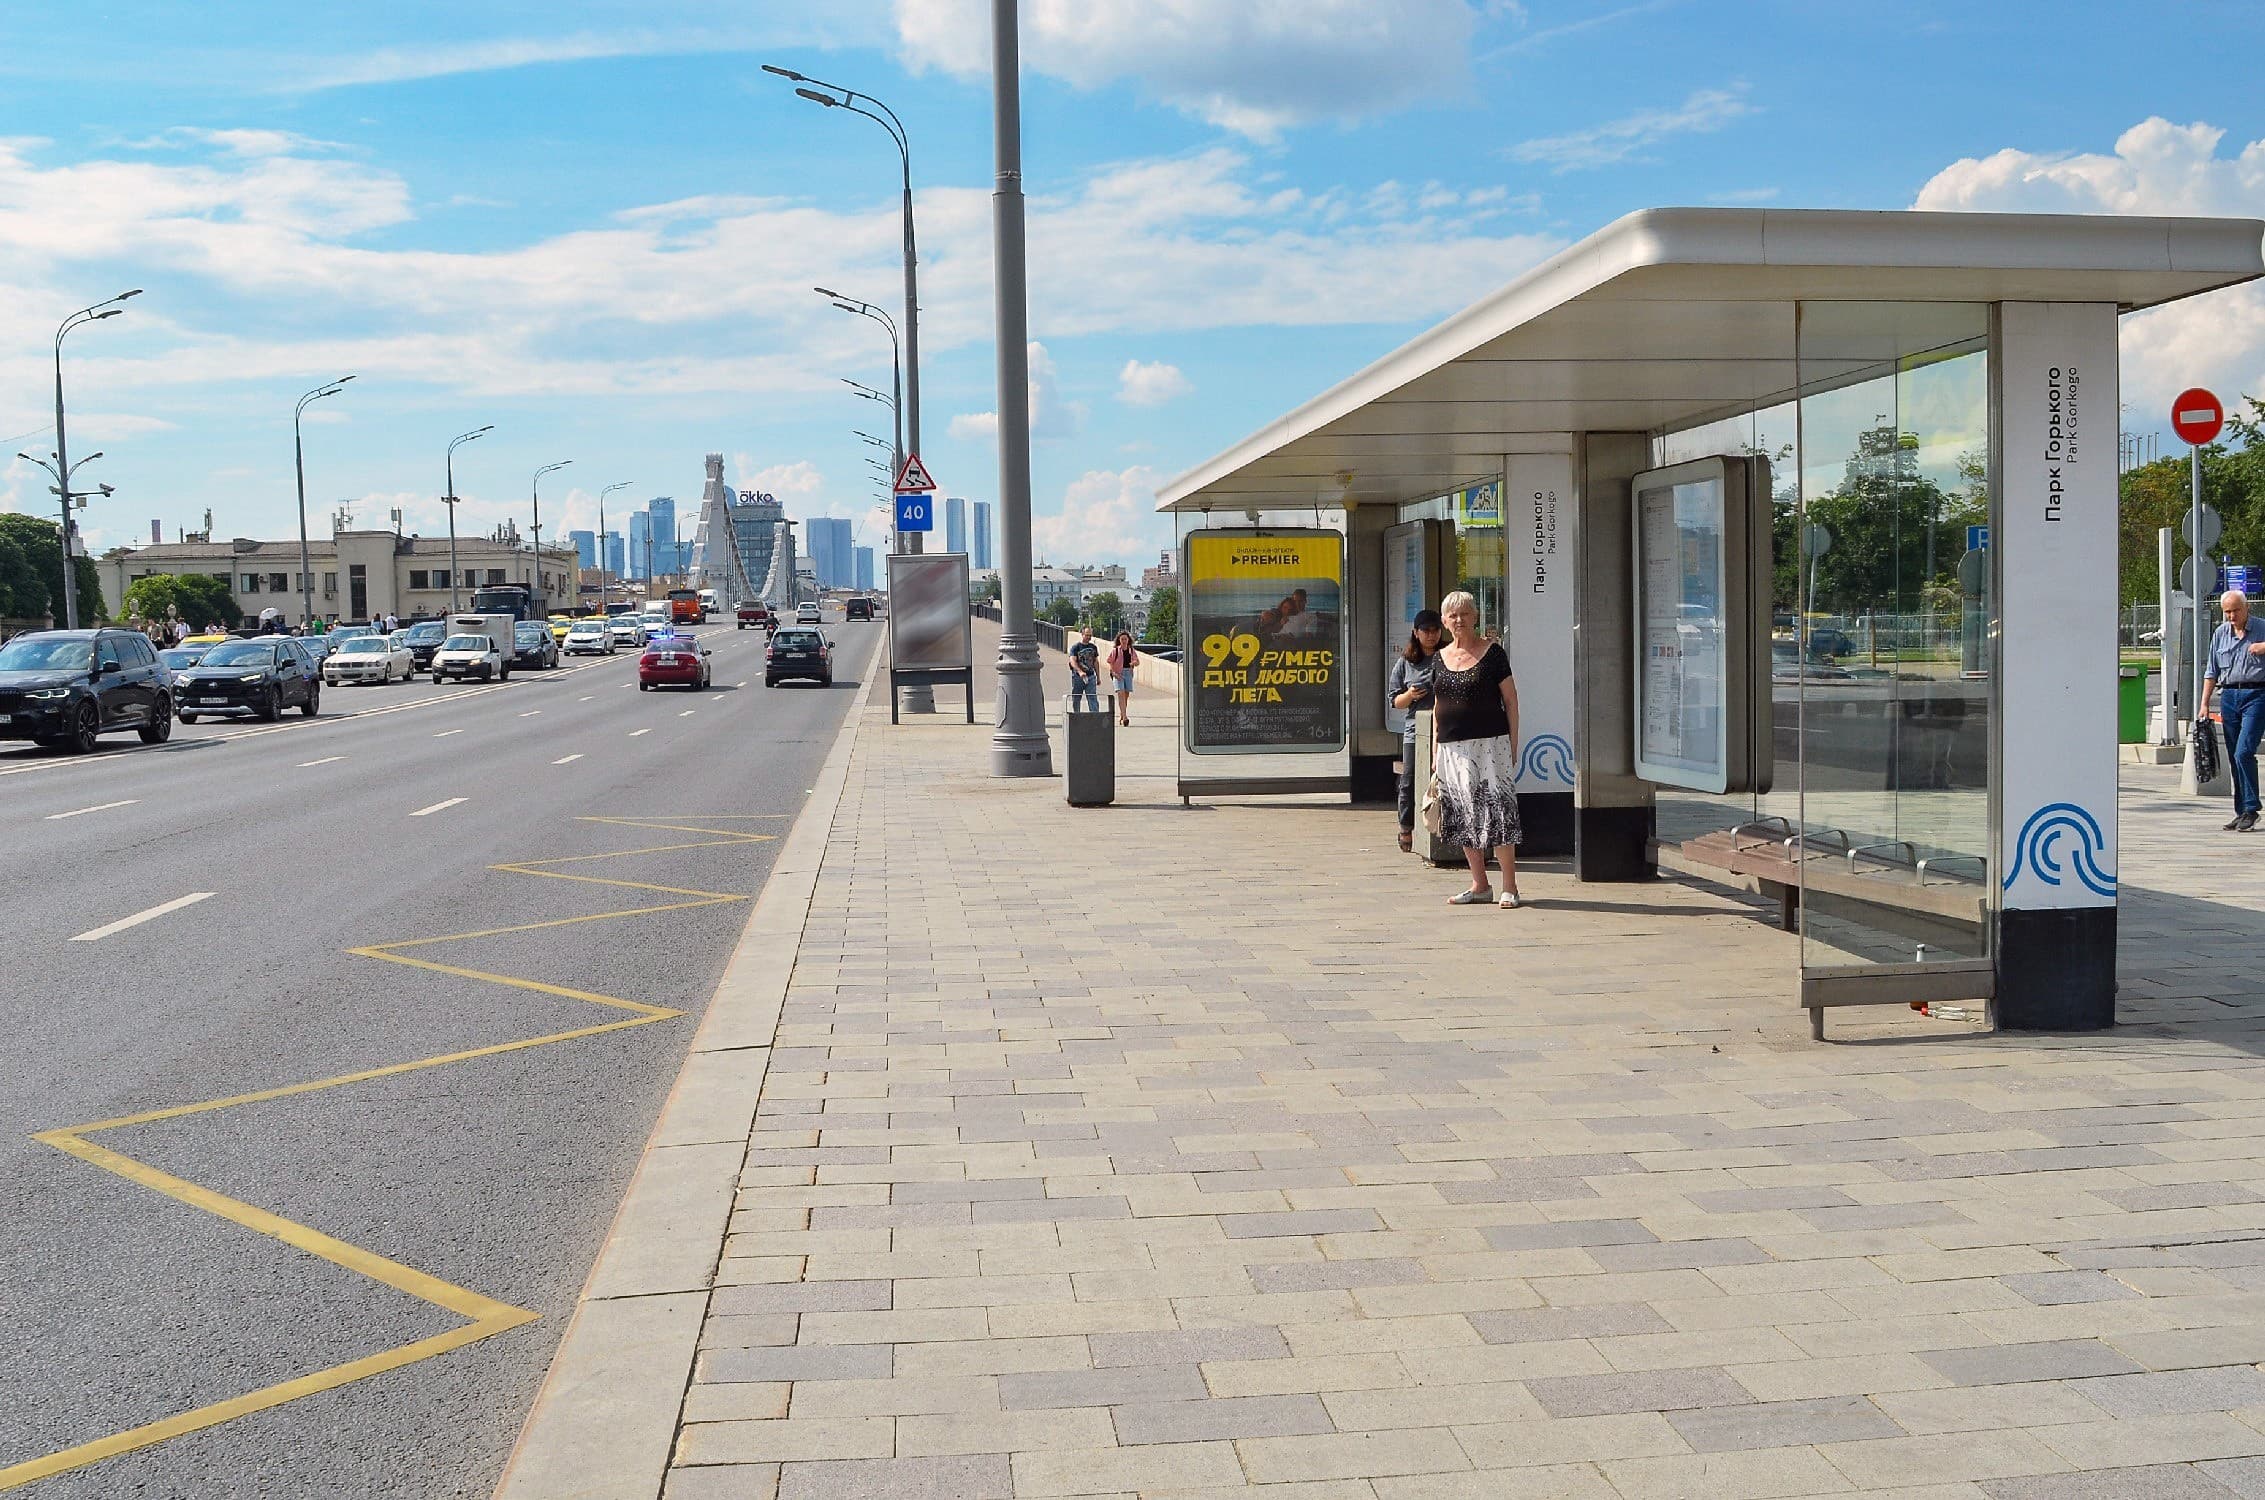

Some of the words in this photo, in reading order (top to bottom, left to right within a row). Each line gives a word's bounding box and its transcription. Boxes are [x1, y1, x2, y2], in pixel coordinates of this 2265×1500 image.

[2045, 367, 2064, 461] Горького
[2066, 367, 2080, 429] Gorkogo
[2066, 431, 2078, 464] Park
[1547, 491, 1557, 532] Gorkogo
[2045, 467, 2065, 522] Парк
[903, 504, 924, 520] 40
[1532, 491, 1546, 555] Горького
[1242, 555, 1300, 565] PREMIER
[1547, 533, 1556, 554] Park
[1533, 558, 1547, 593] Парк
[1202, 633, 1261, 668] 99
[1202, 670, 1248, 688] ДЛЯ
[1254, 668, 1329, 685] ЛЮБОГО
[1229, 687, 1283, 703] ЛЕТА
[1308, 725, 1334, 738] 16+
